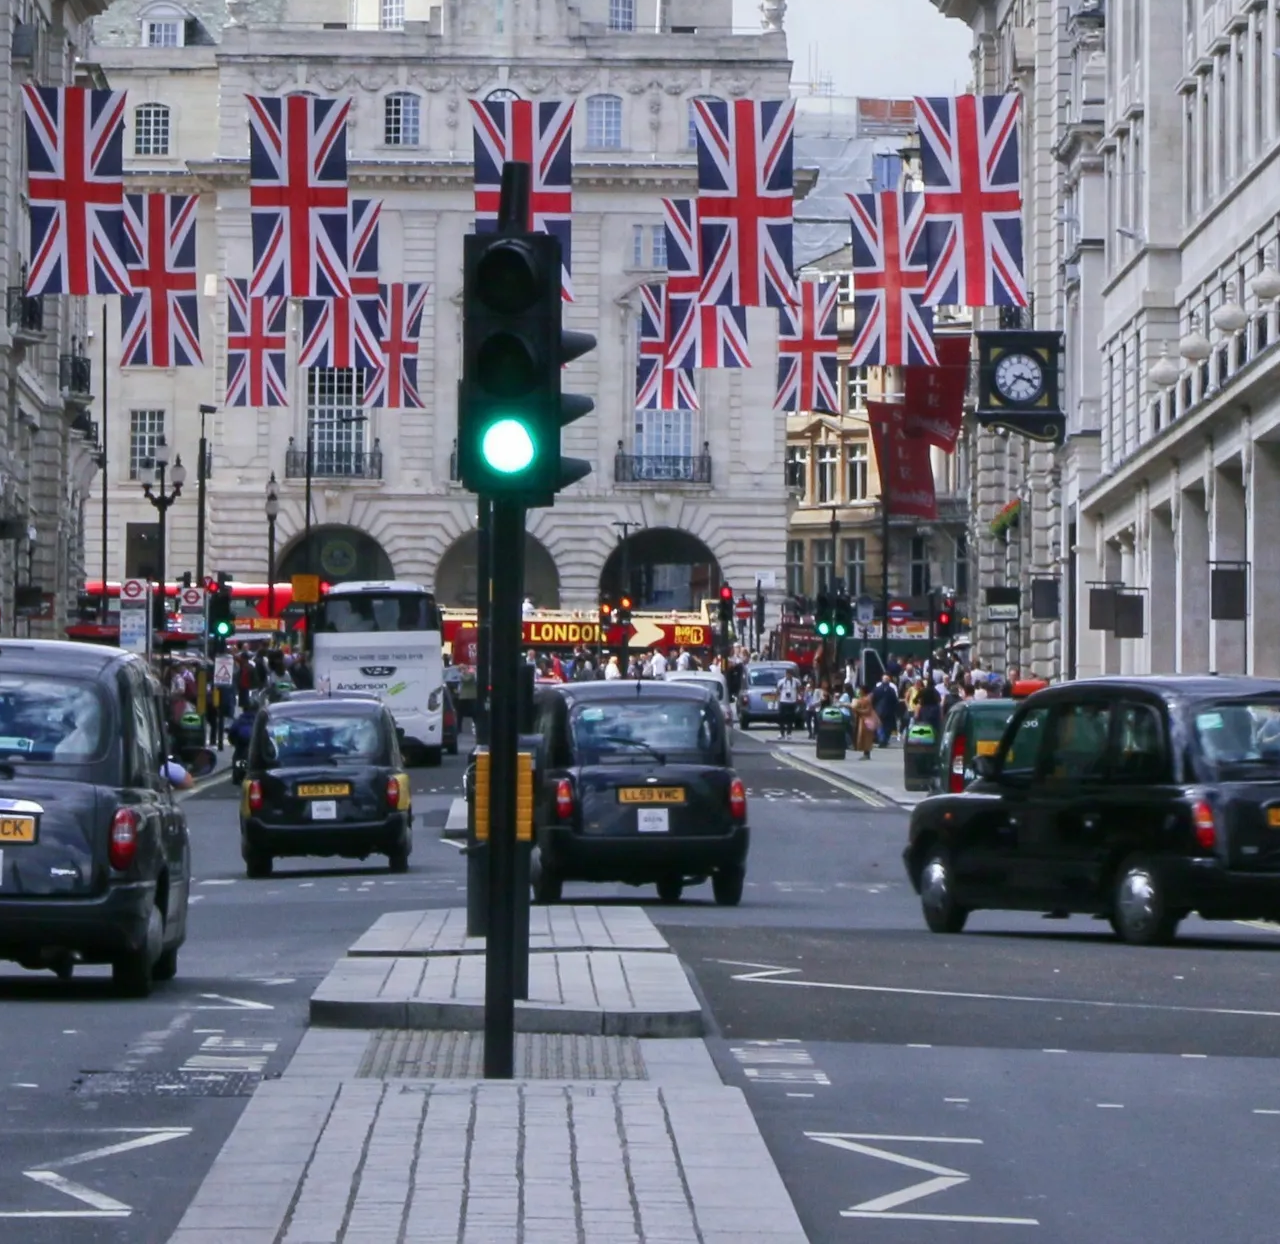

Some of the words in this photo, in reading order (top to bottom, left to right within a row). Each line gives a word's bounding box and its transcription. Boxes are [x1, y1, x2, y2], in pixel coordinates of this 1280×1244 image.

[530, 624, 607, 642] LONDON
[674, 626, 691, 636] BIG
[336, 682, 388, 691] Anderson
